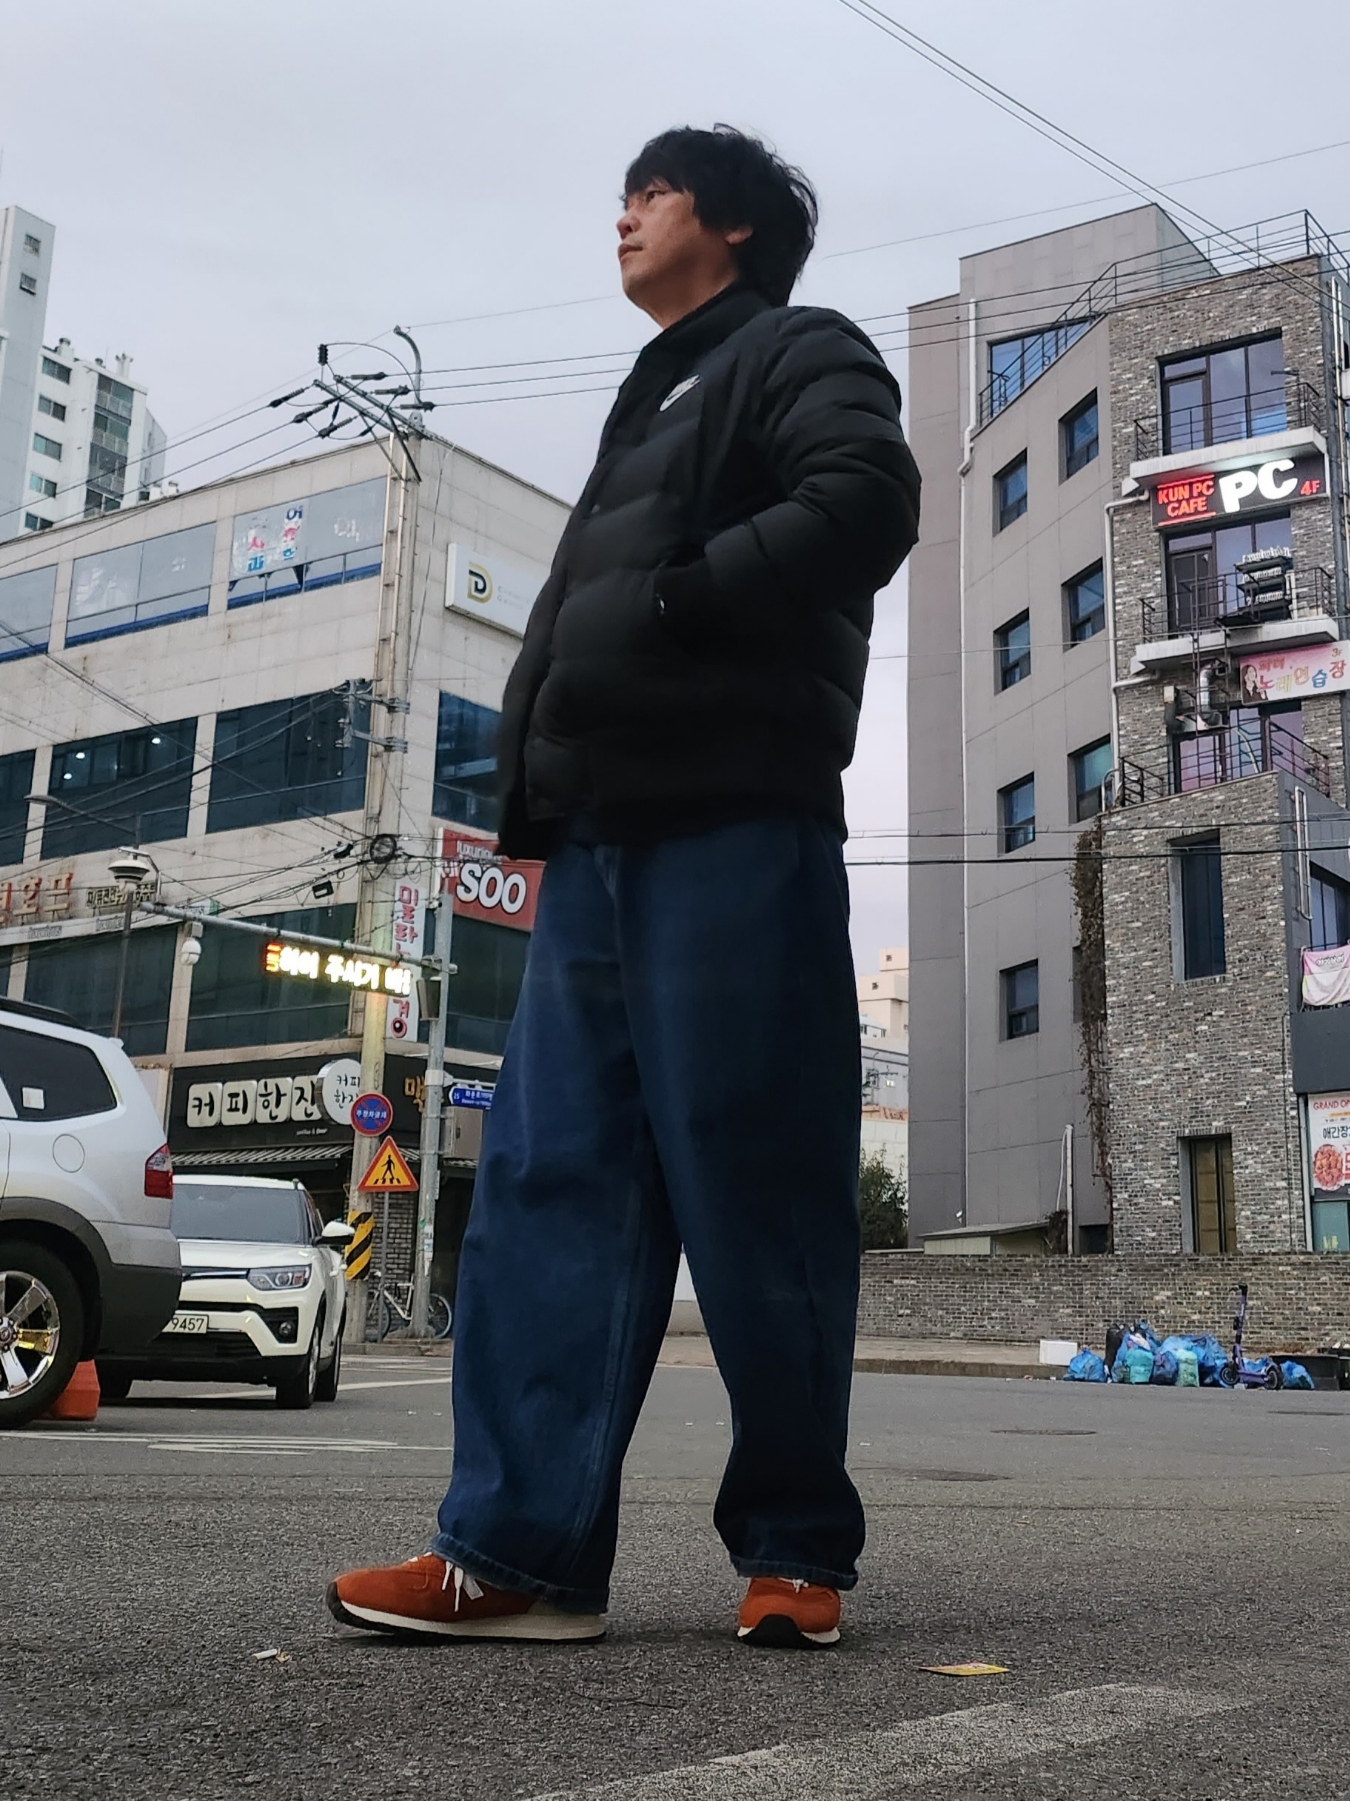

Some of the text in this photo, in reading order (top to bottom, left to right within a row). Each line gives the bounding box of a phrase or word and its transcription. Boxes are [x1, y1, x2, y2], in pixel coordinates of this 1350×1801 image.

[1158, 480, 1214, 504] KUN PC
[1219, 458, 1298, 513] PC
[1300, 480, 1320, 495] 4F
[1167, 497, 1207, 517] CAFE
[1259, 660, 1346, 692] 노래연습장
[456, 863, 527, 914] SOO
[390, 885, 418, 1038] 밀라노경
[336, 1074, 360, 1088] 커피
[1313, 1100, 1339, 1110] GRAND
[1323, 1125, 1350, 1139] 애간장
[171, 1317, 205, 1331] 9457
